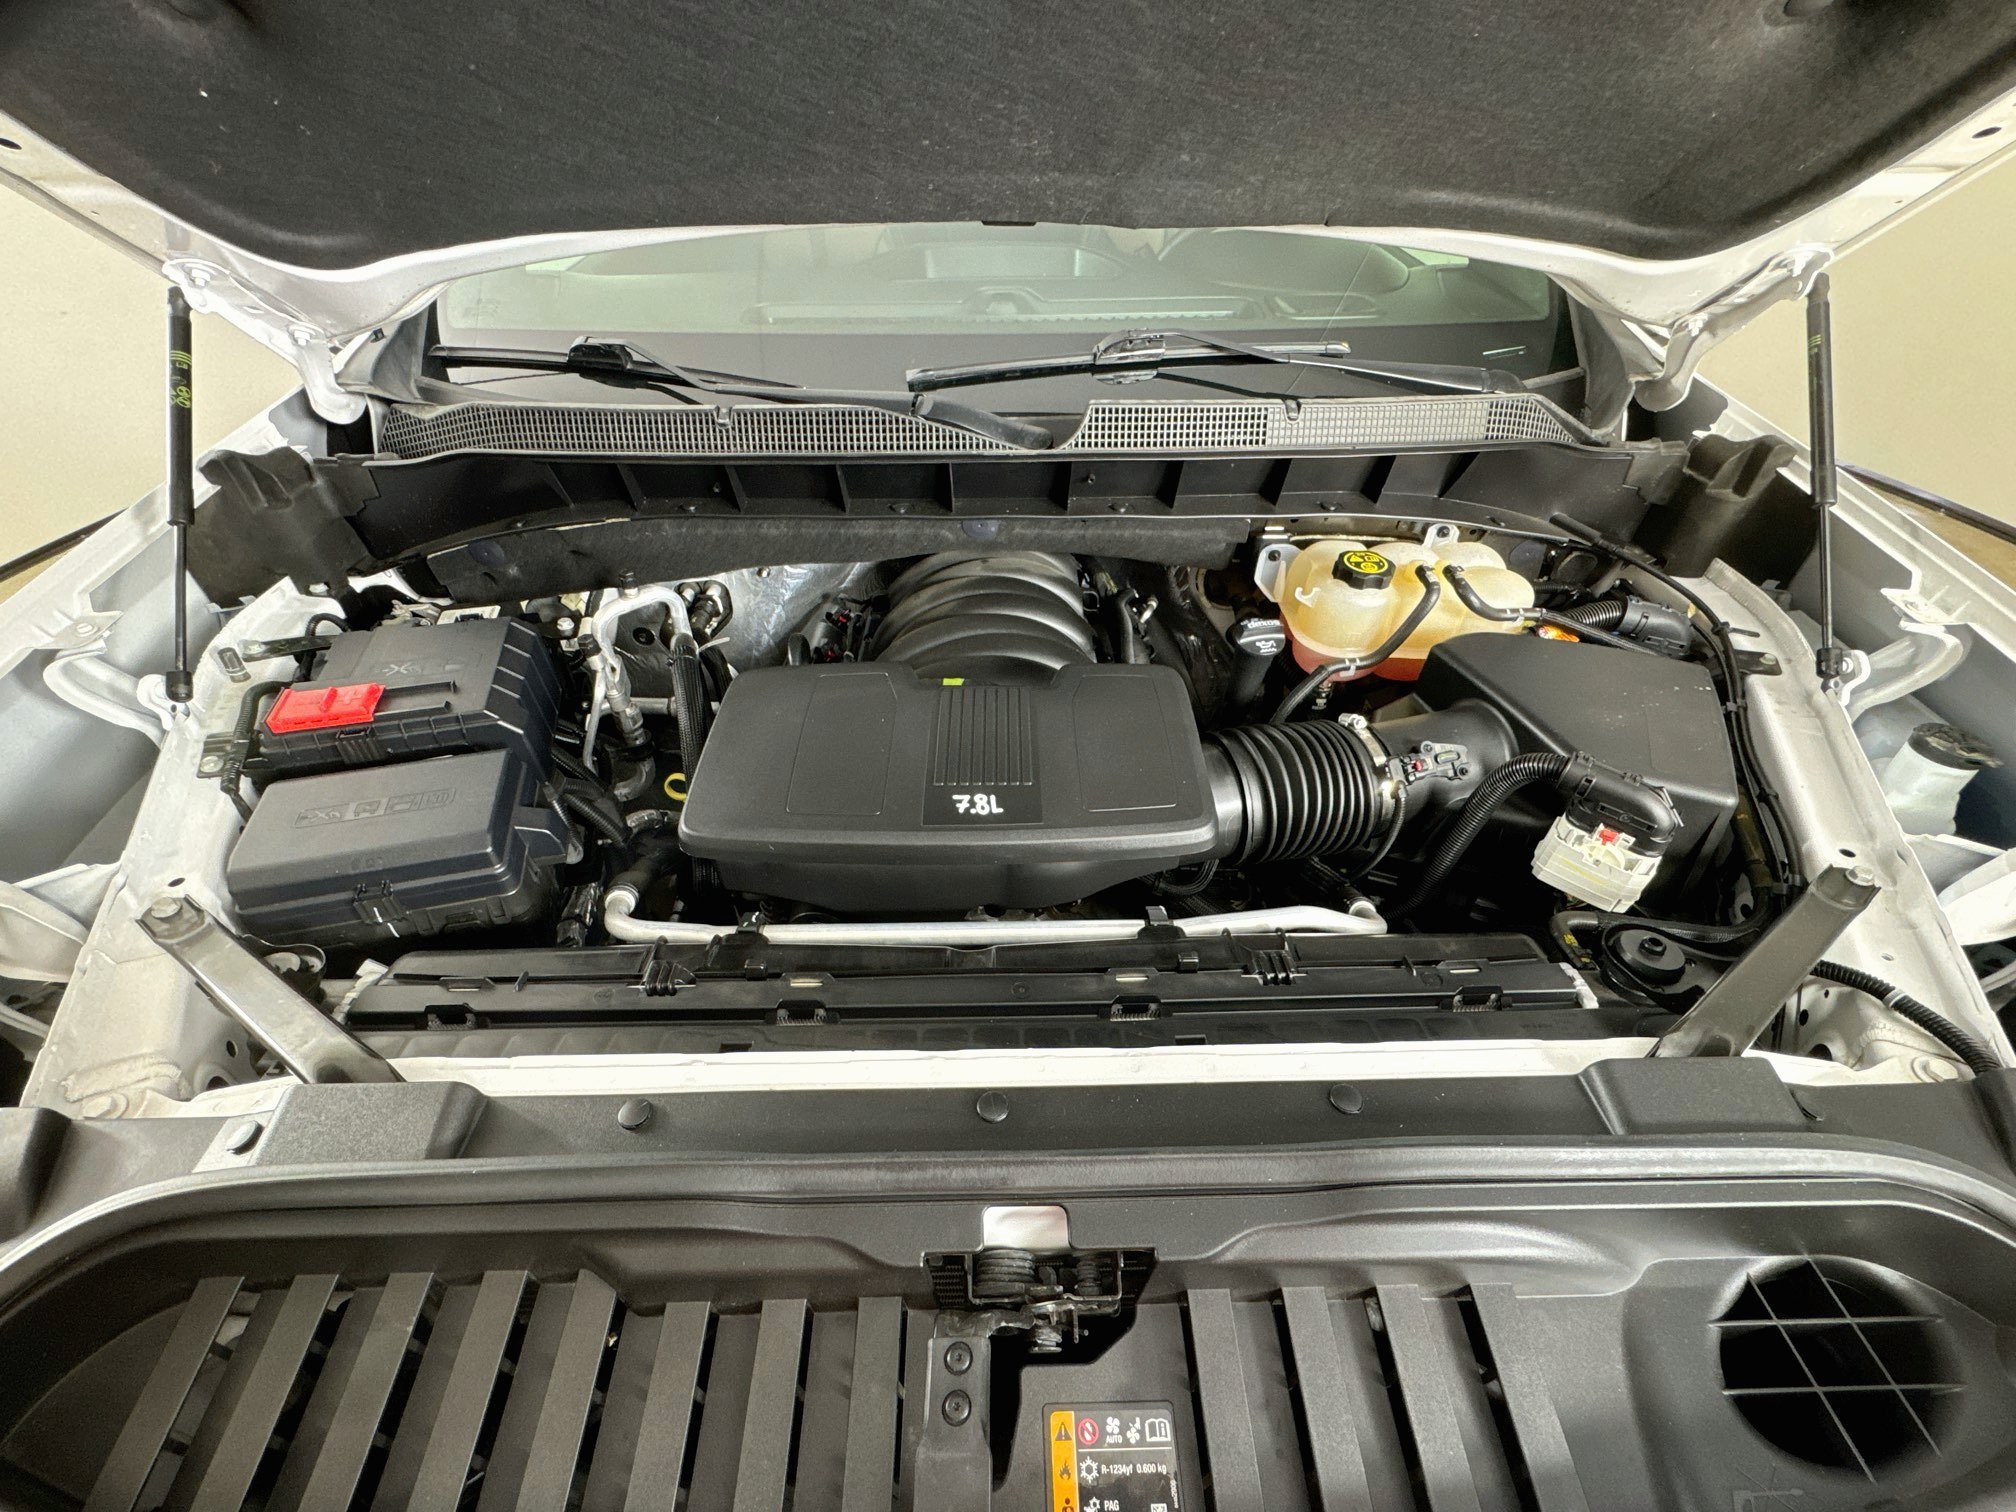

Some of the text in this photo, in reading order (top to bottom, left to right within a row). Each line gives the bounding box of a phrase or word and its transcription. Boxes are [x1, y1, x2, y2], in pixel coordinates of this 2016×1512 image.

[952, 793, 1004, 815] 7.8L
[1106, 1435, 1122, 1443] AUTO
[1101, 1463, 1167, 1476] R-1234yf 0.600 kg
[1104, 1500, 1120, 1511] PAG
